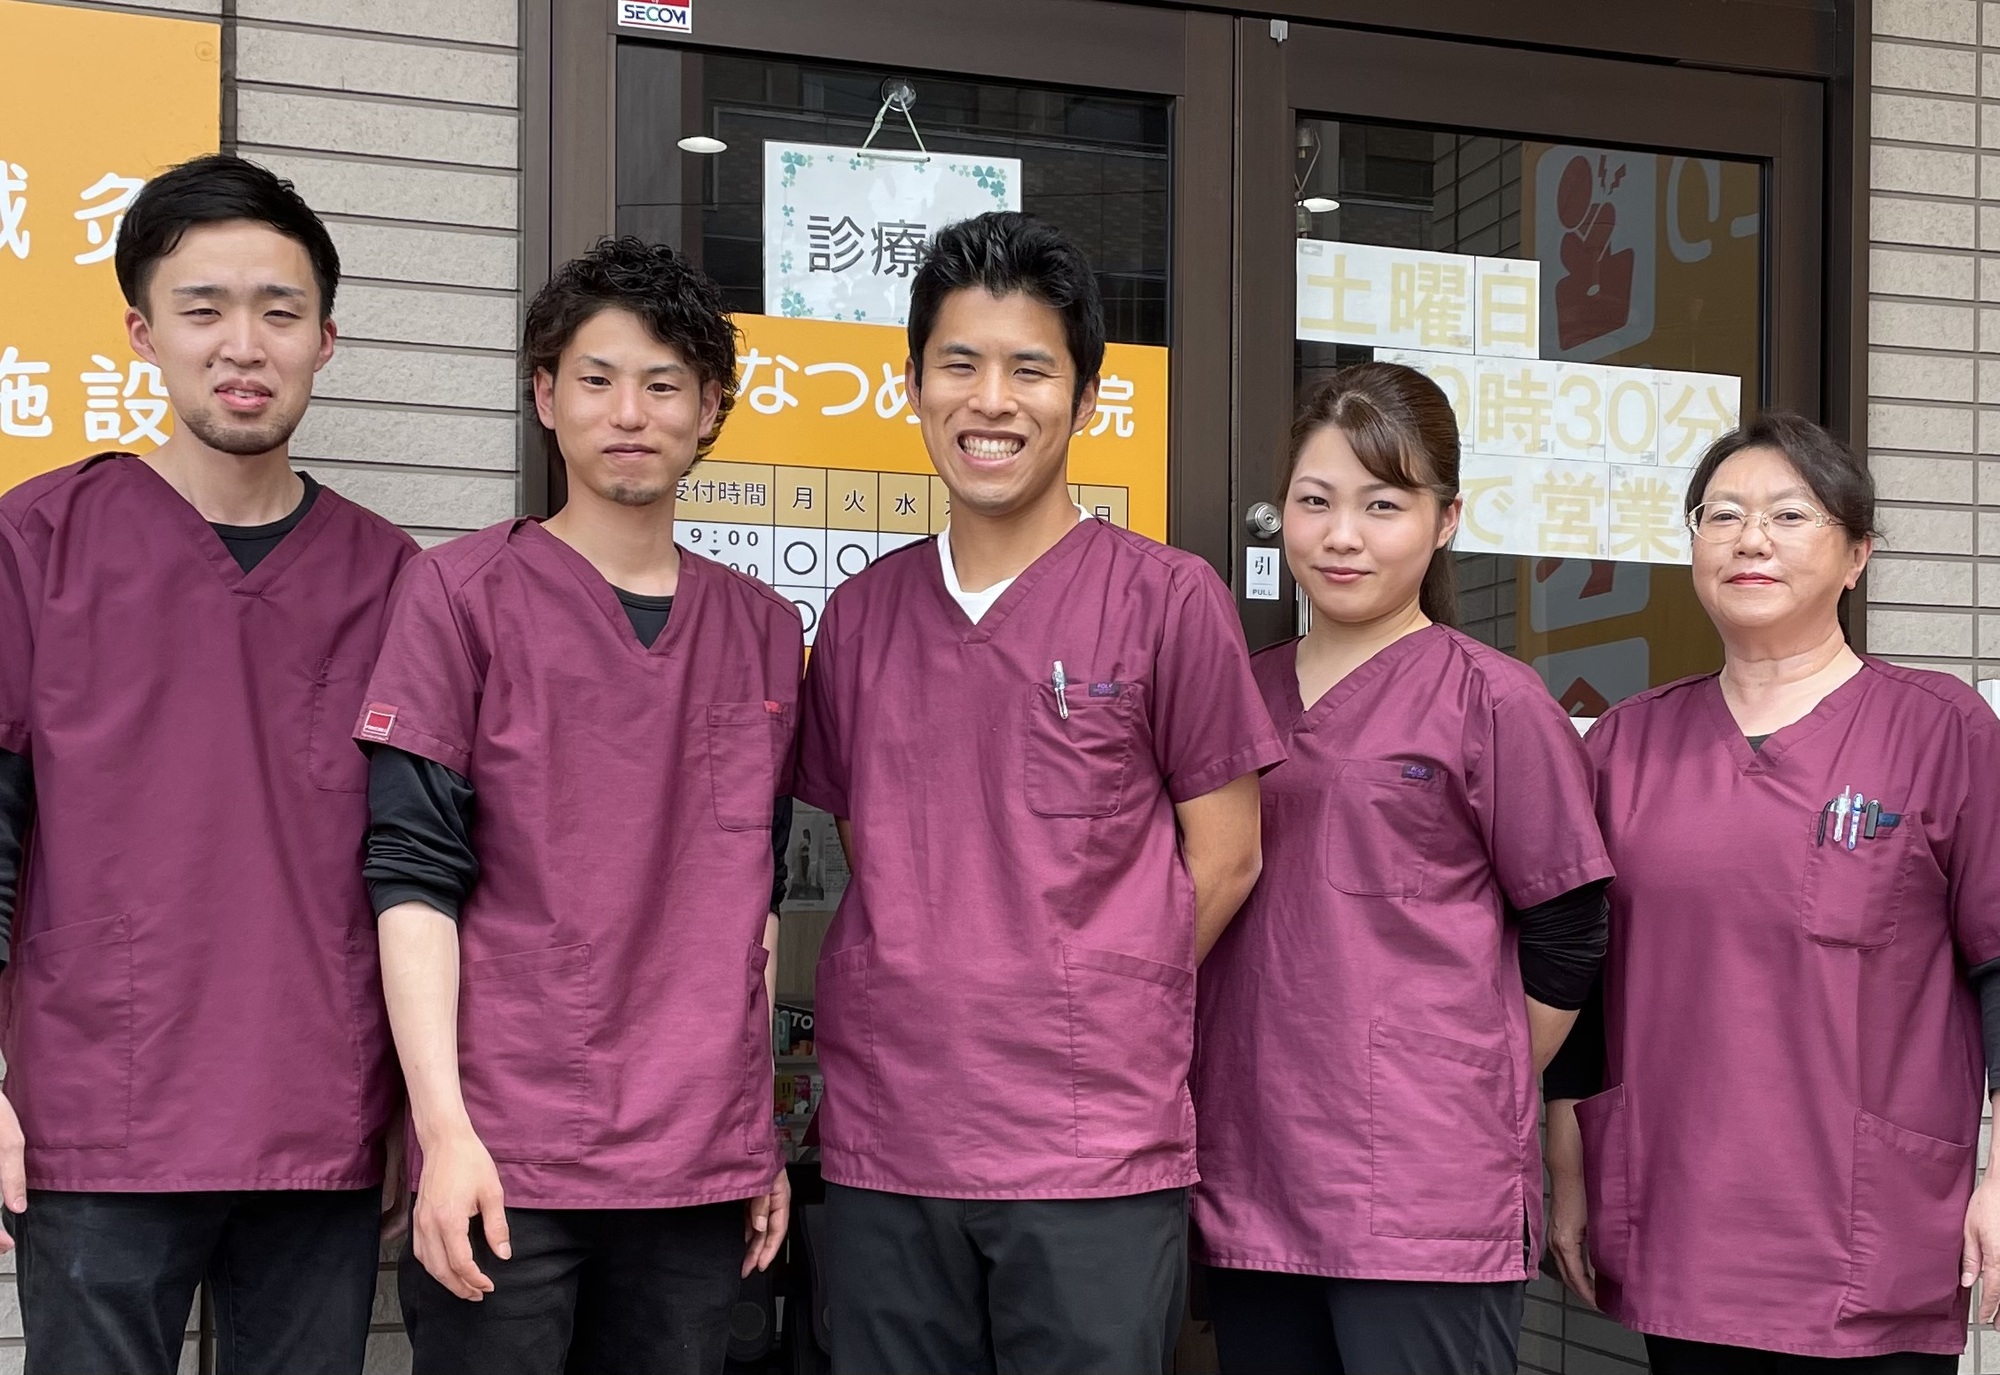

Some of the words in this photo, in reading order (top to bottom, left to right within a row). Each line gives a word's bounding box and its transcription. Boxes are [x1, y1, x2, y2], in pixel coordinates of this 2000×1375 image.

[624, 4, 686, 25] SECOM
[807, 215, 930, 278] 診療
[1300, 254, 1537, 348] 土曜日
[792, 486, 813, 510] 月
[844, 490, 866, 513] 火
[895, 493, 917, 516] 水
[1255, 556, 1270, 575] 引
